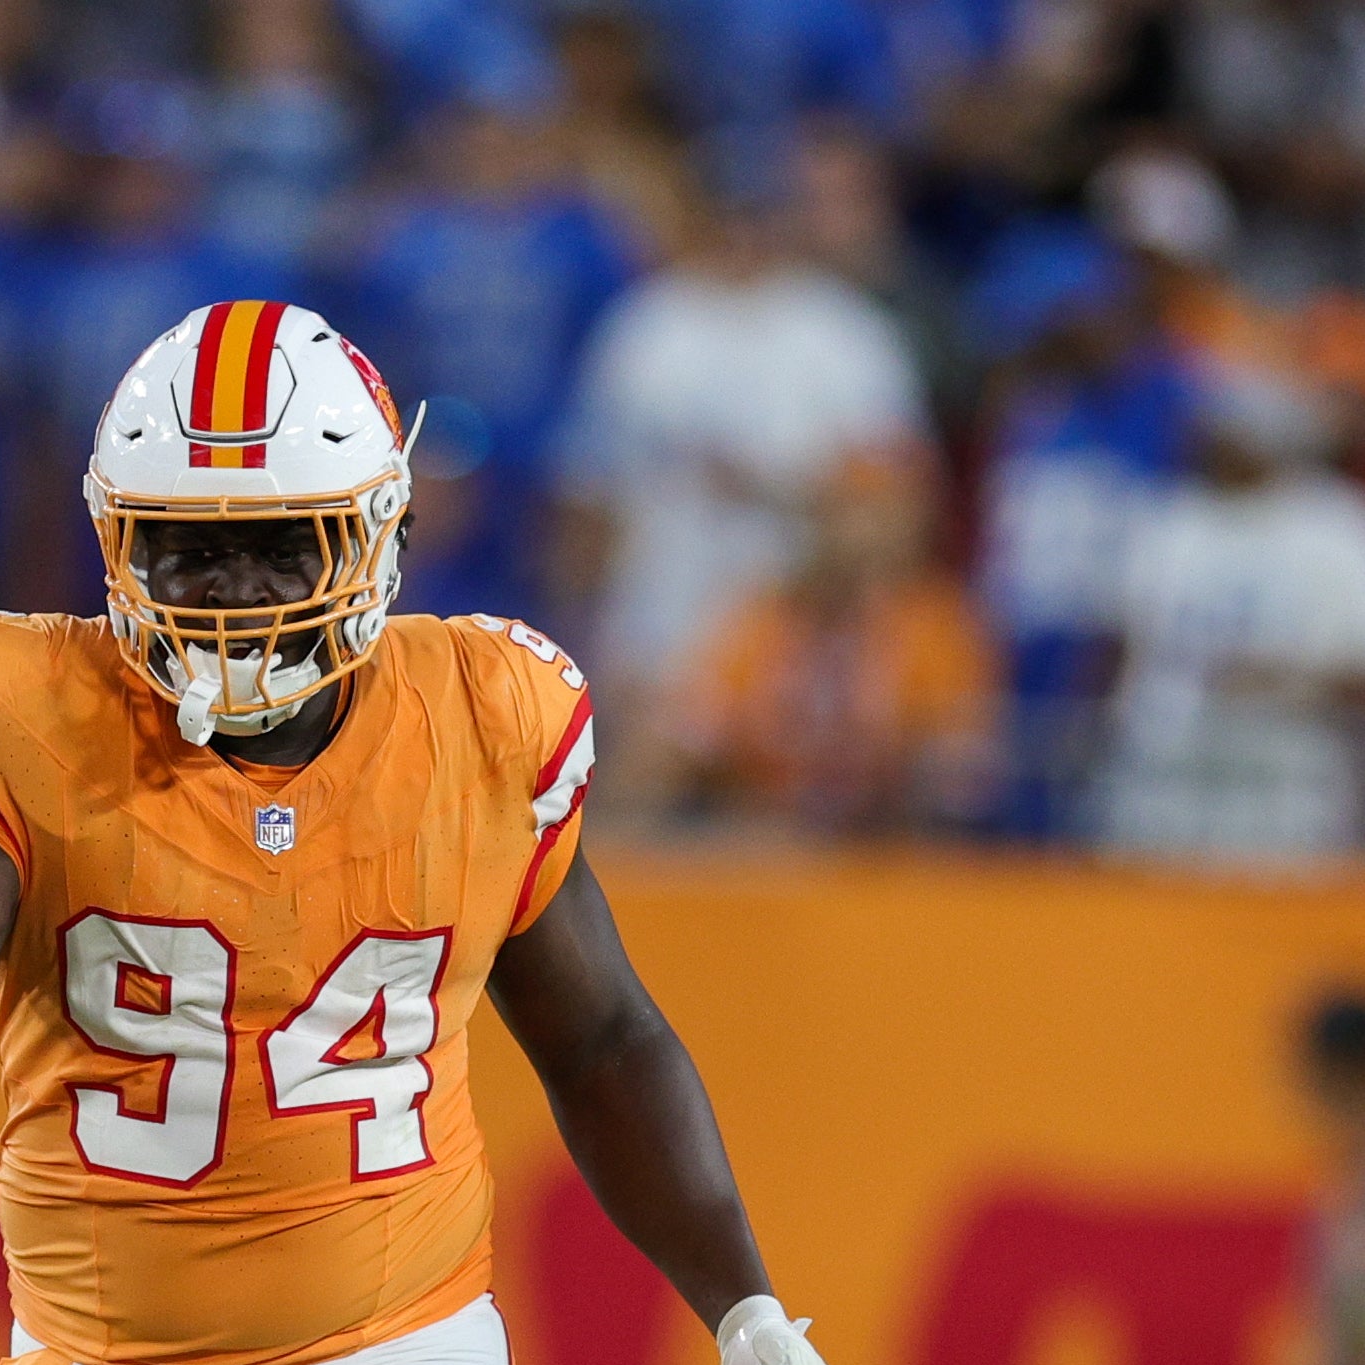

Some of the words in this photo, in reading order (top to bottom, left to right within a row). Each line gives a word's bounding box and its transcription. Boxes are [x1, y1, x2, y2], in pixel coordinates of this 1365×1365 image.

[506, 618, 588, 691] 9
[261, 825, 289, 844] NFL
[56, 906, 454, 1190] 94
